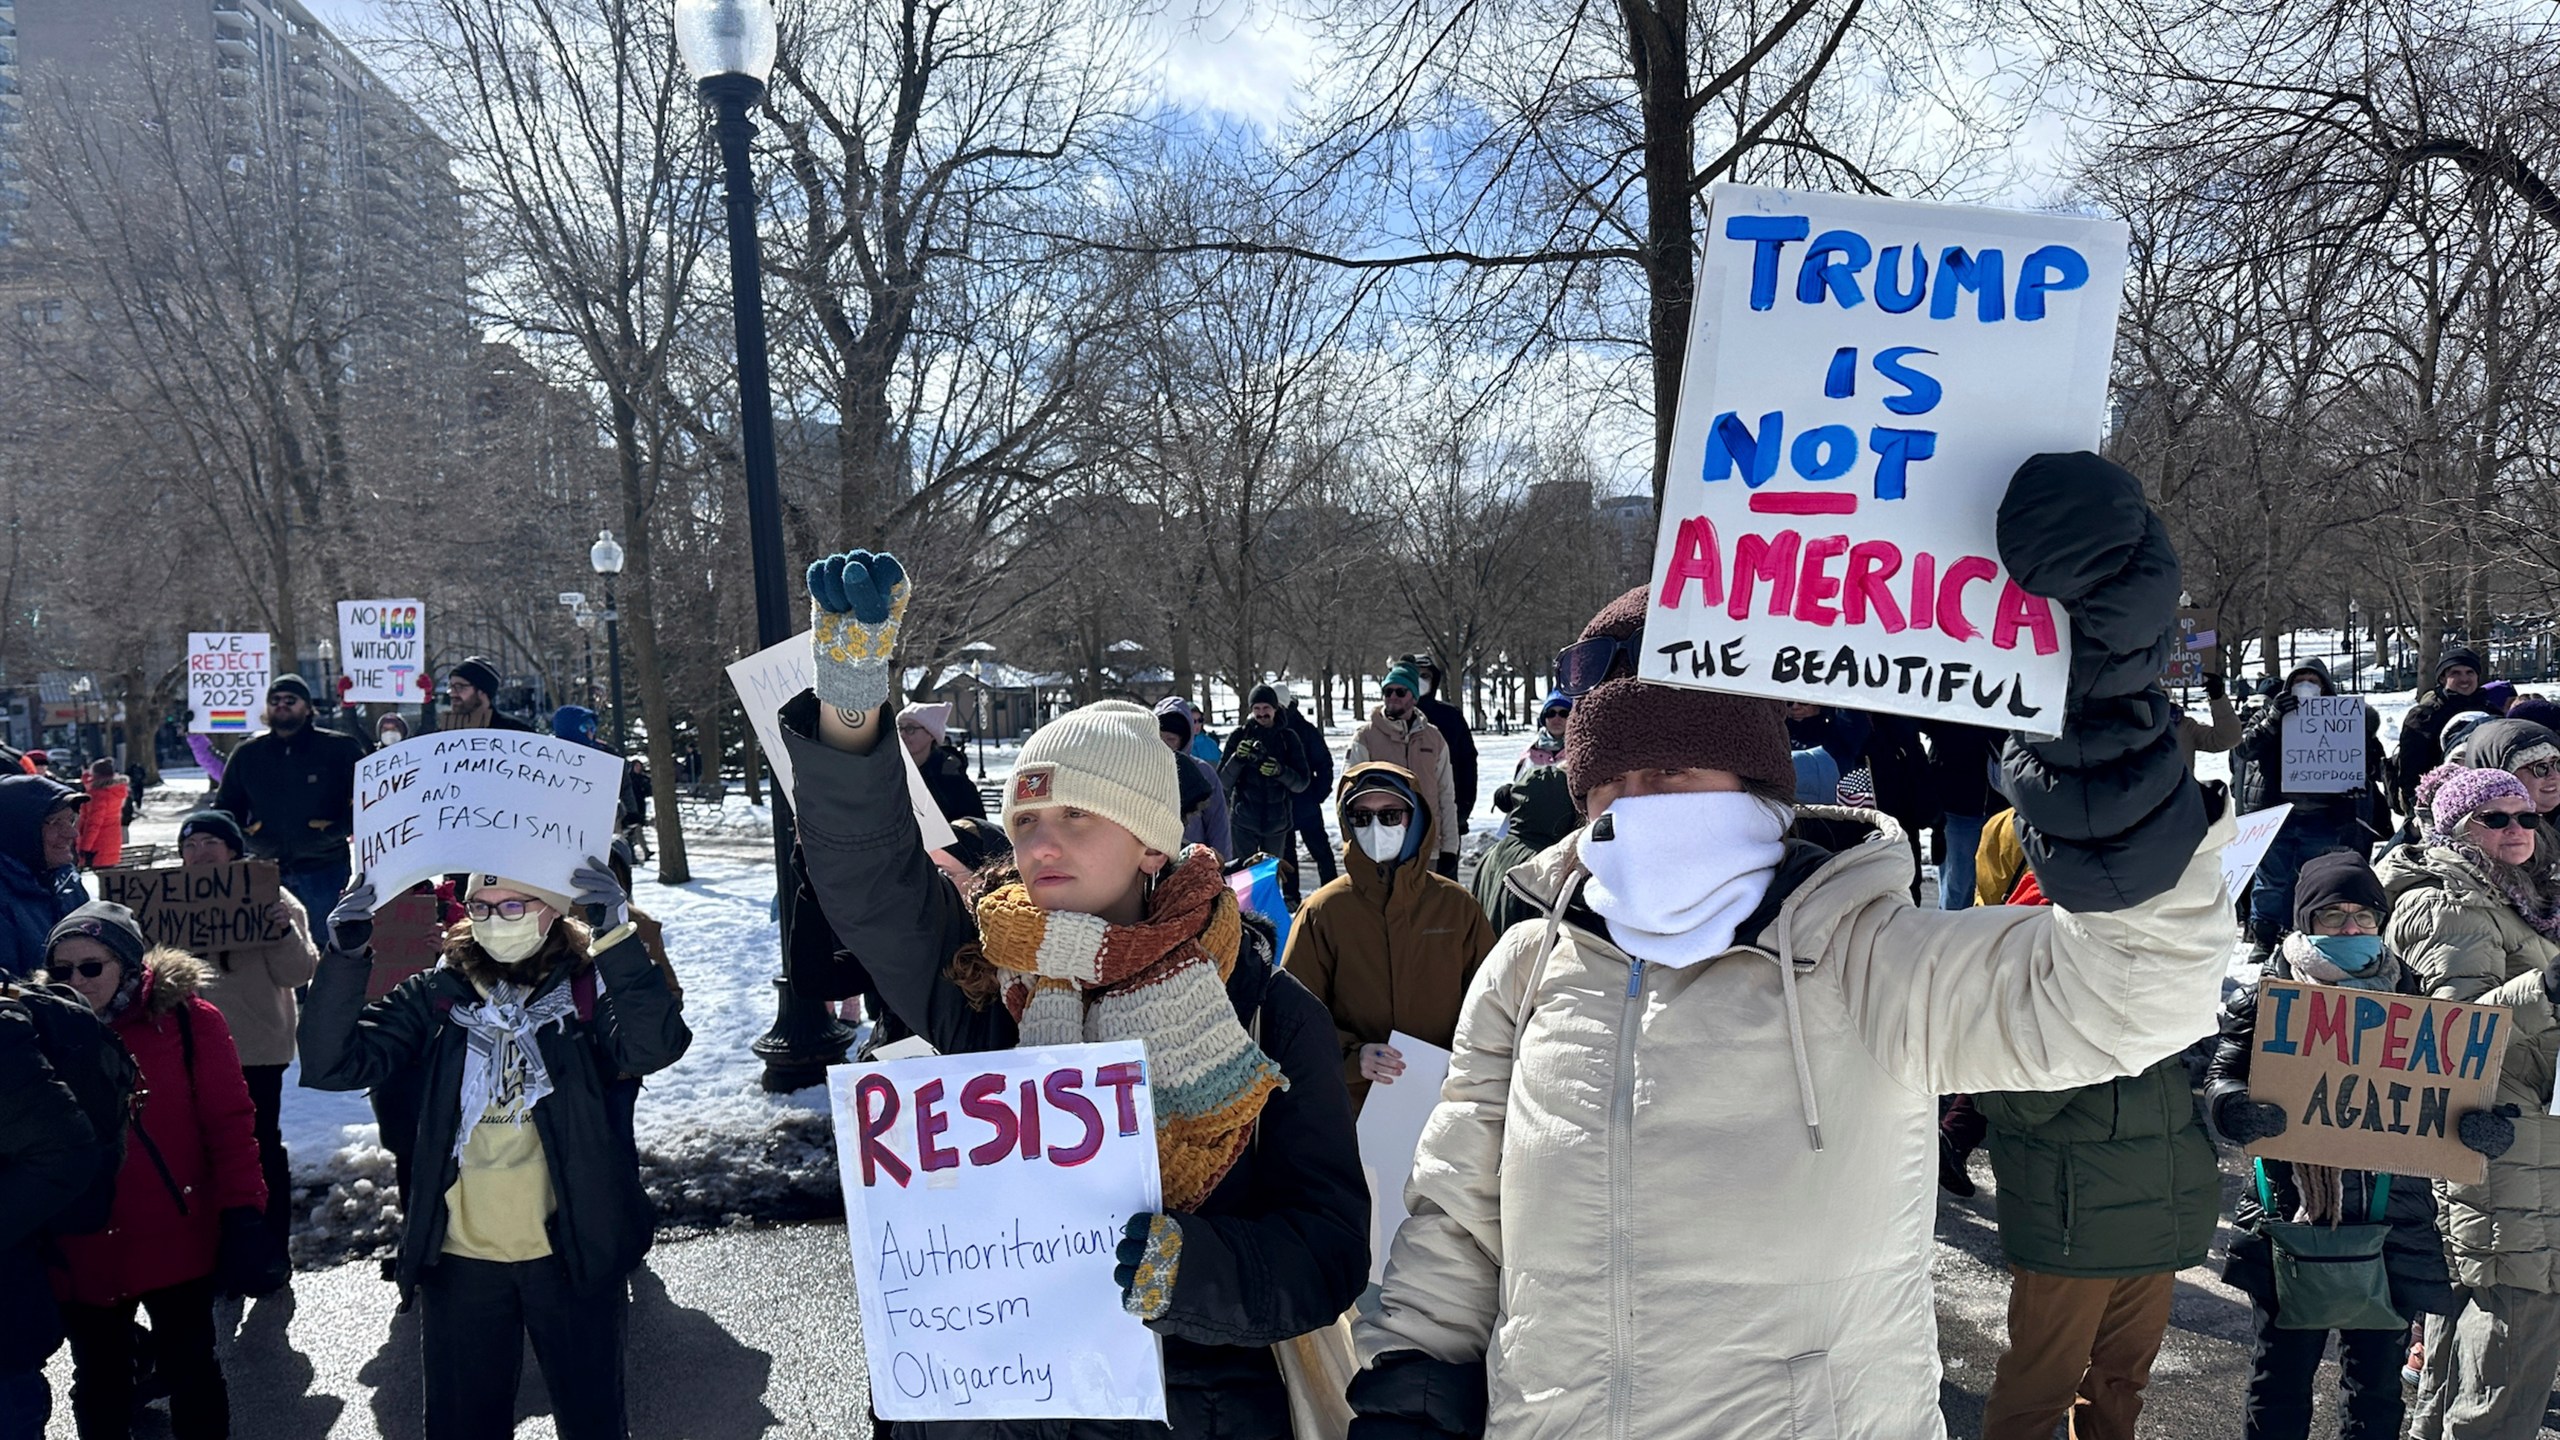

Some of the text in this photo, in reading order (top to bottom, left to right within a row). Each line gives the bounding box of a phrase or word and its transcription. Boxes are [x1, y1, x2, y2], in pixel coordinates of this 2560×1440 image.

[1725, 214, 2090, 324] TRUMP
[1824, 345, 1943, 416] IS
[1702, 410, 1938, 500] NOT
[1659, 514, 2060, 656] AMERICA
[205, 636, 242, 652] WE
[351, 607, 416, 639] NO LGB
[191, 652, 264, 670] REJECT
[351, 640, 416, 660] WITHOUT
[193, 671, 268, 688] PROJECT
[202, 689, 254, 706] 2025
[353, 665, 414, 697] THE T
[750, 656, 811, 710] MAK
[1657, 635, 2042, 718] THE BEAUTIFUL
[2296, 698, 2362, 717] MERICA
[2300, 718, 2356, 734] IS NOT
[363, 738, 586, 783] REAL AMERICANS
[2319, 734, 2330, 748] A
[362, 758, 594, 811] LOVE IMMIGRANTS
[422, 783, 461, 803] AND
[2289, 770, 2364, 782] #STOPDOGE
[361, 815, 423, 873] HATE
[2262, 988, 2499, 1080] IMPEACH
[855, 1060, 1146, 1189] RESIST
[2302, 1071, 2450, 1139] AGAIN
[884, 1288, 1030, 1337] Fascism
[893, 1350, 1054, 1406] Oligarchy
